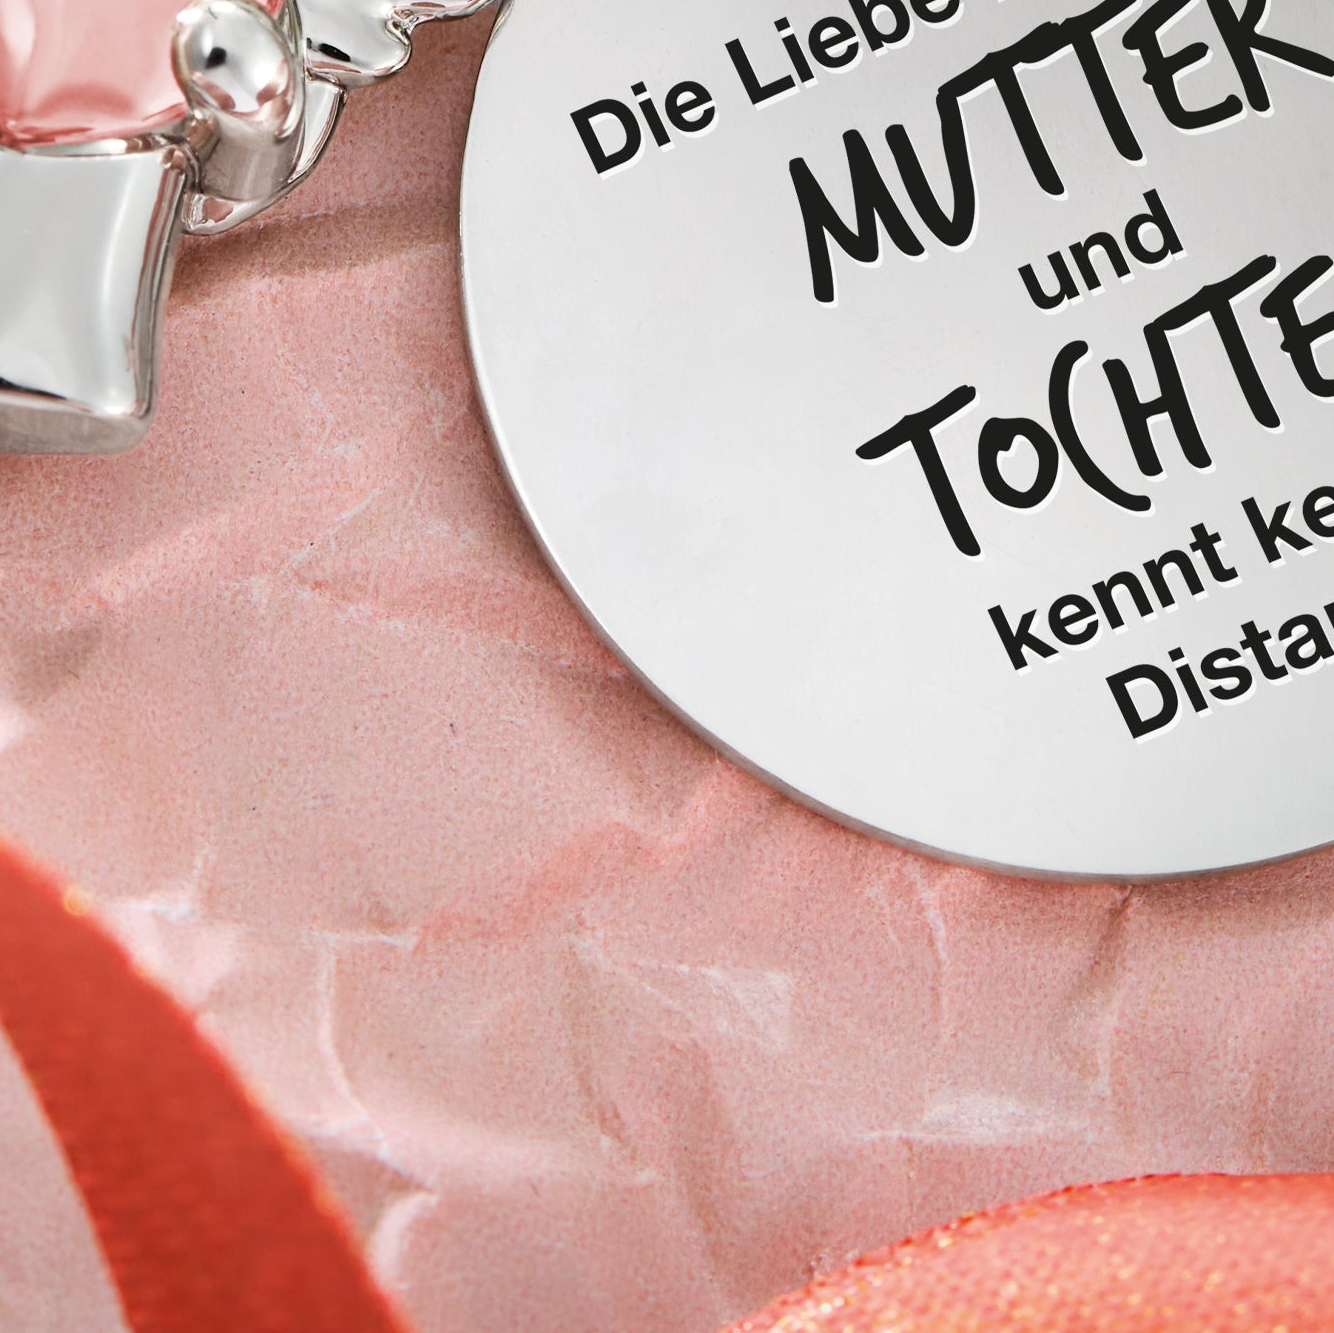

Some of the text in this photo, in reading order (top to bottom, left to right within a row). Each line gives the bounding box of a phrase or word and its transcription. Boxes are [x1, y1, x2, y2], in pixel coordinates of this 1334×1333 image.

[570, 78, 716, 174] Die
[1017, 188, 1185, 310] und
[987, 522, 1239, 671] kennt
